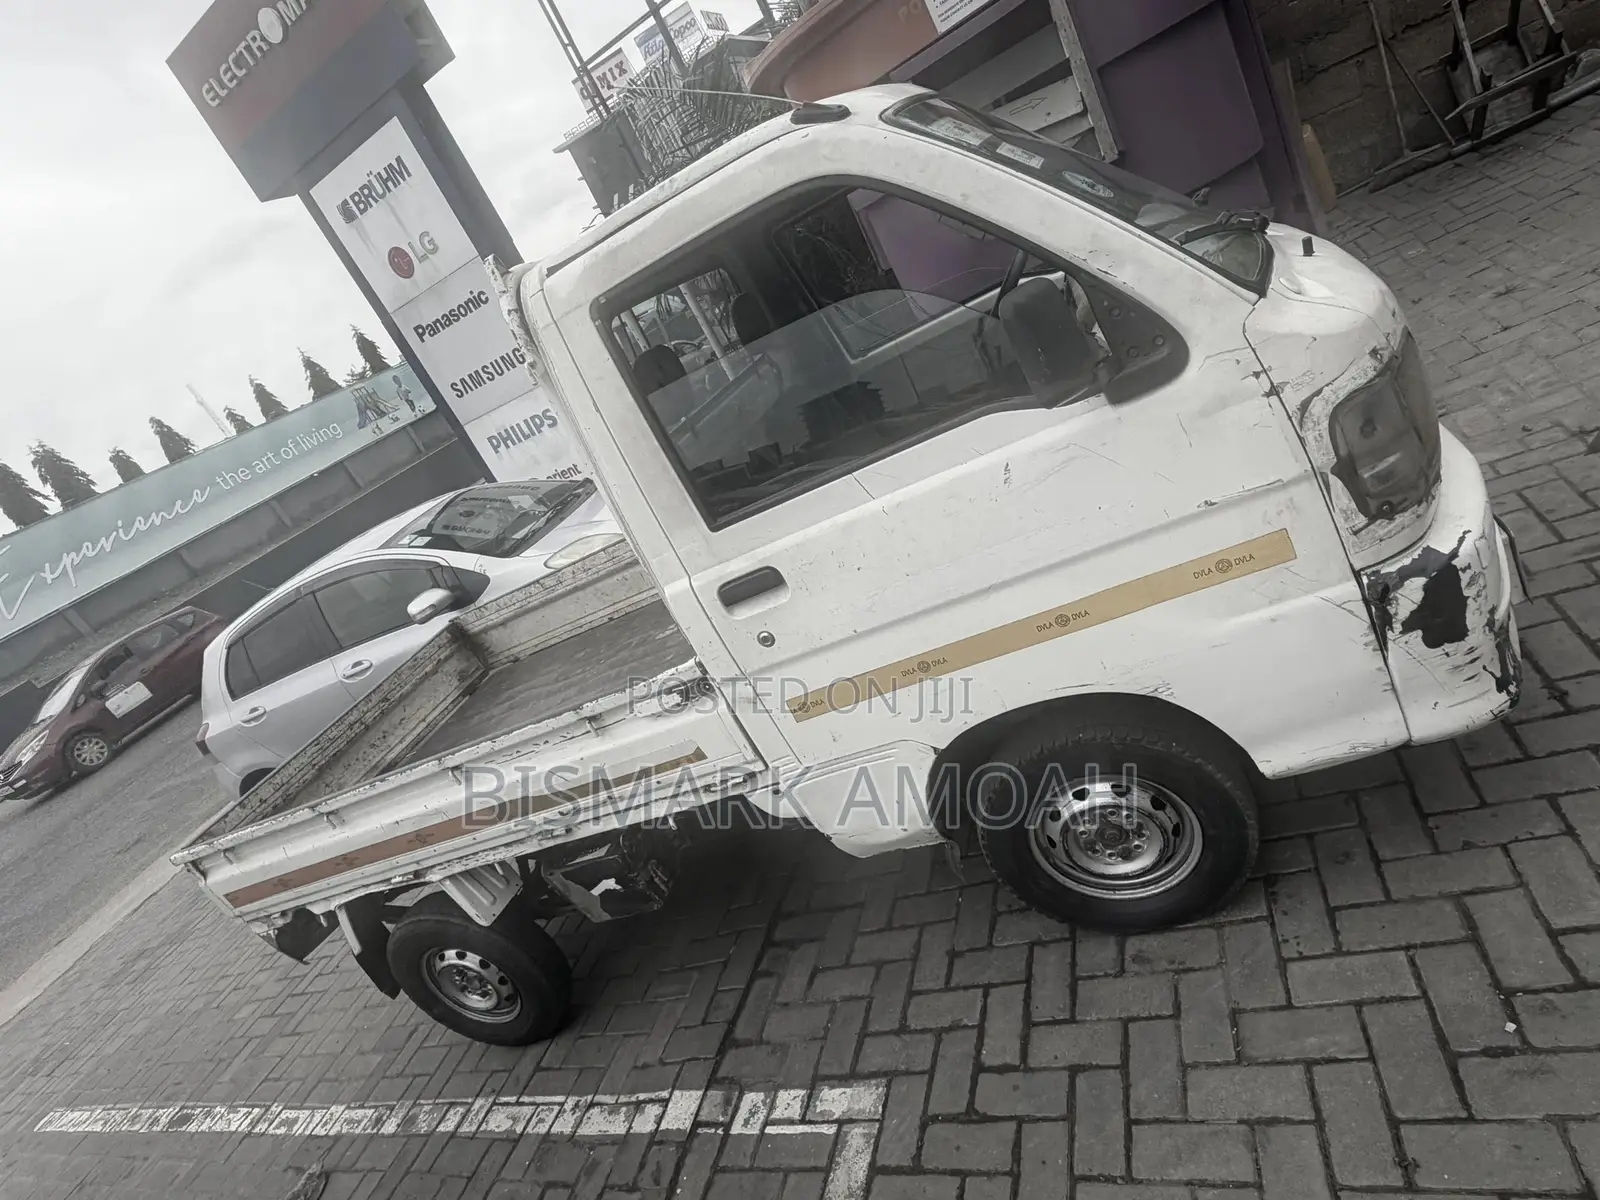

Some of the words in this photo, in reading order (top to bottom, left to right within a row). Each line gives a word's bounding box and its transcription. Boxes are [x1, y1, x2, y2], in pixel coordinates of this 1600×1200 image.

[202, 0, 307, 107] ELECTROM
[349, 155, 412, 216] BRÜHM
[408, 231, 439, 264] LG
[413, 290, 489, 343] Panasonic
[450, 347, 526, 398] SAMSUNG
[216, 471, 252, 490] the
[252, 451, 280, 473] art
[280, 439, 300, 460] of
[296, 423, 343, 451] living
[486, 408, 558, 454] PHILIPS
[811, 698, 825, 709] DVLA
[901, 667, 918, 677] DVLA
[931, 657, 949, 668] DVLA
[1036, 622, 1055, 633] DVLA
[1071, 610, 1090, 621] DVLA
[1193, 567, 1213, 580] DVLA
[1234, 553, 1256, 566] DVLA
